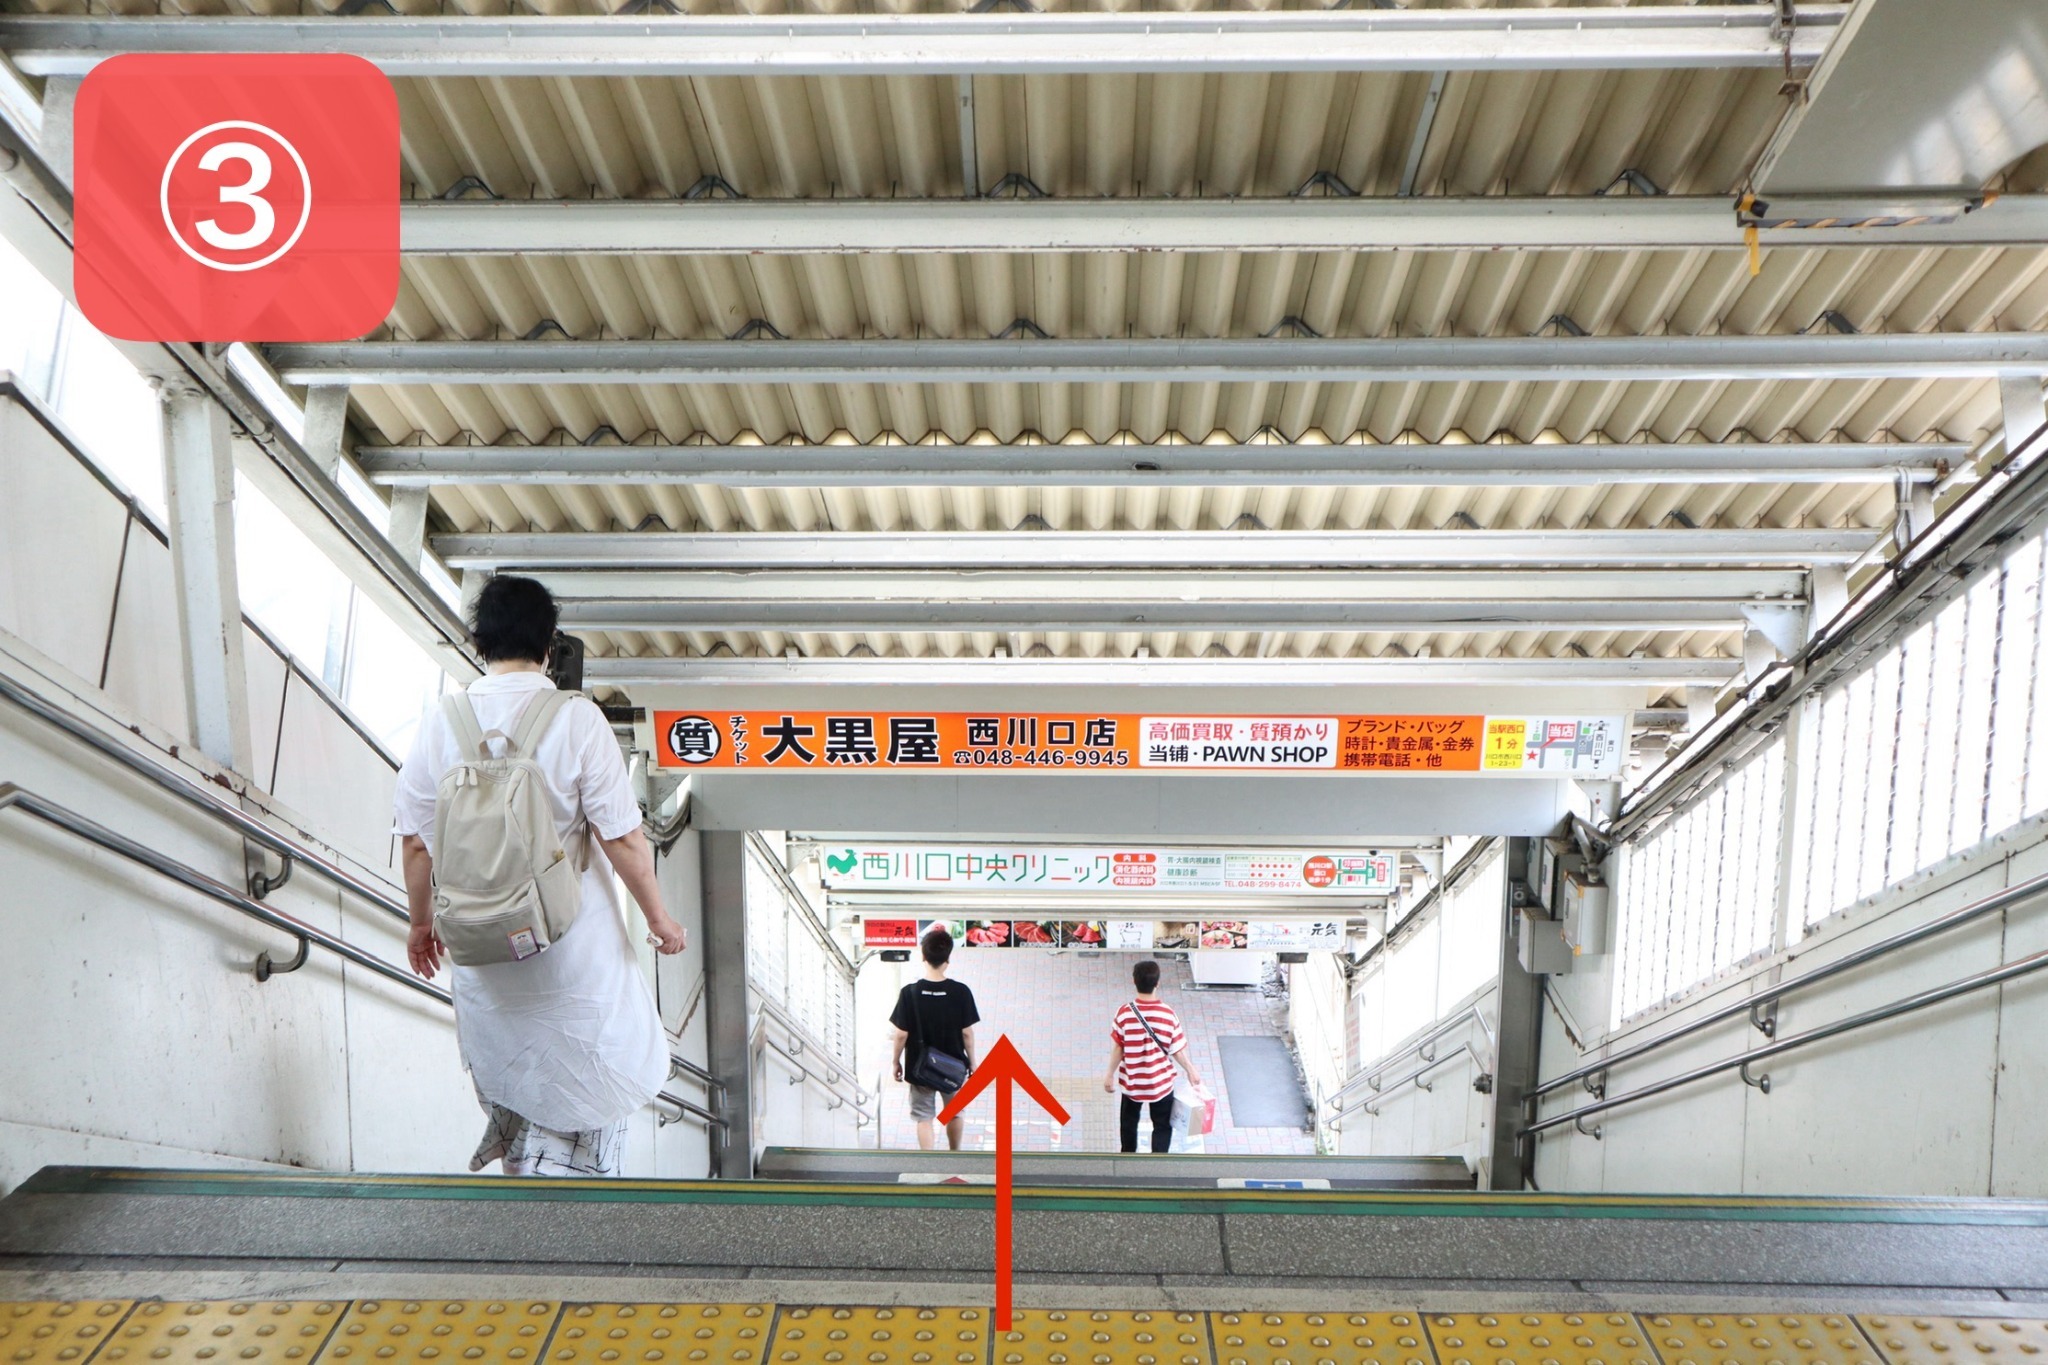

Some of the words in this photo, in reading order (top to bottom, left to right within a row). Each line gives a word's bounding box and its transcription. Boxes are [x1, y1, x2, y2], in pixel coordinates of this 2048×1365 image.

[674, 721, 715, 758] 質
[730, 715, 748, 764] チケット
[761, 716, 940, 764] 大黒屋
[966, 718, 1117, 747] 西川口店
[1488, 724, 1525, 734] 当駅西口
[1548, 725, 1576, 737] 当店
[973, 748, 1129, 767] 048-446-9945
[1271, 745, 1329, 763] SHOP
[862, 852, 1110, 884] 西川口中央クリニック
[1310, 922, 1338, 936] 元気
